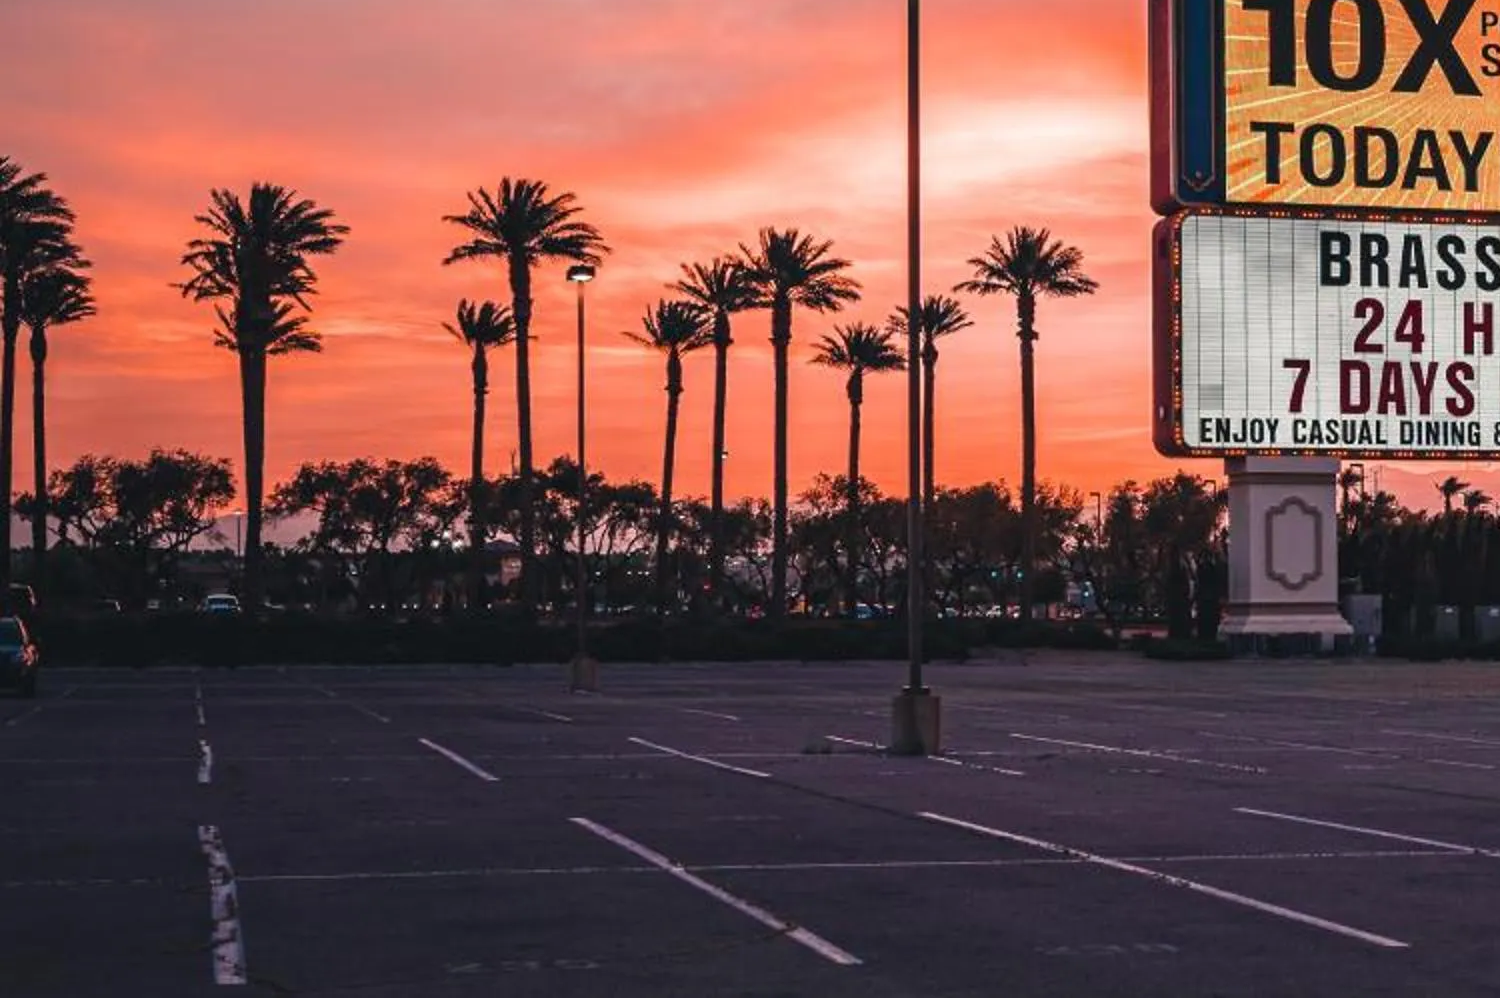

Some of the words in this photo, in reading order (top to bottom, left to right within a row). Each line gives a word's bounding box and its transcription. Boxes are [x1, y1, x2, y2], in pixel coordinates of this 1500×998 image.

[1353, 298, 1425, 354] 24
[1283, 359, 1311, 413] 7
[1340, 360, 1476, 417] DAYS
[1200, 418, 1279, 444] ENJOY
[1292, 419, 1387, 445] CASUAL
[1399, 421, 1481, 446] DINING
